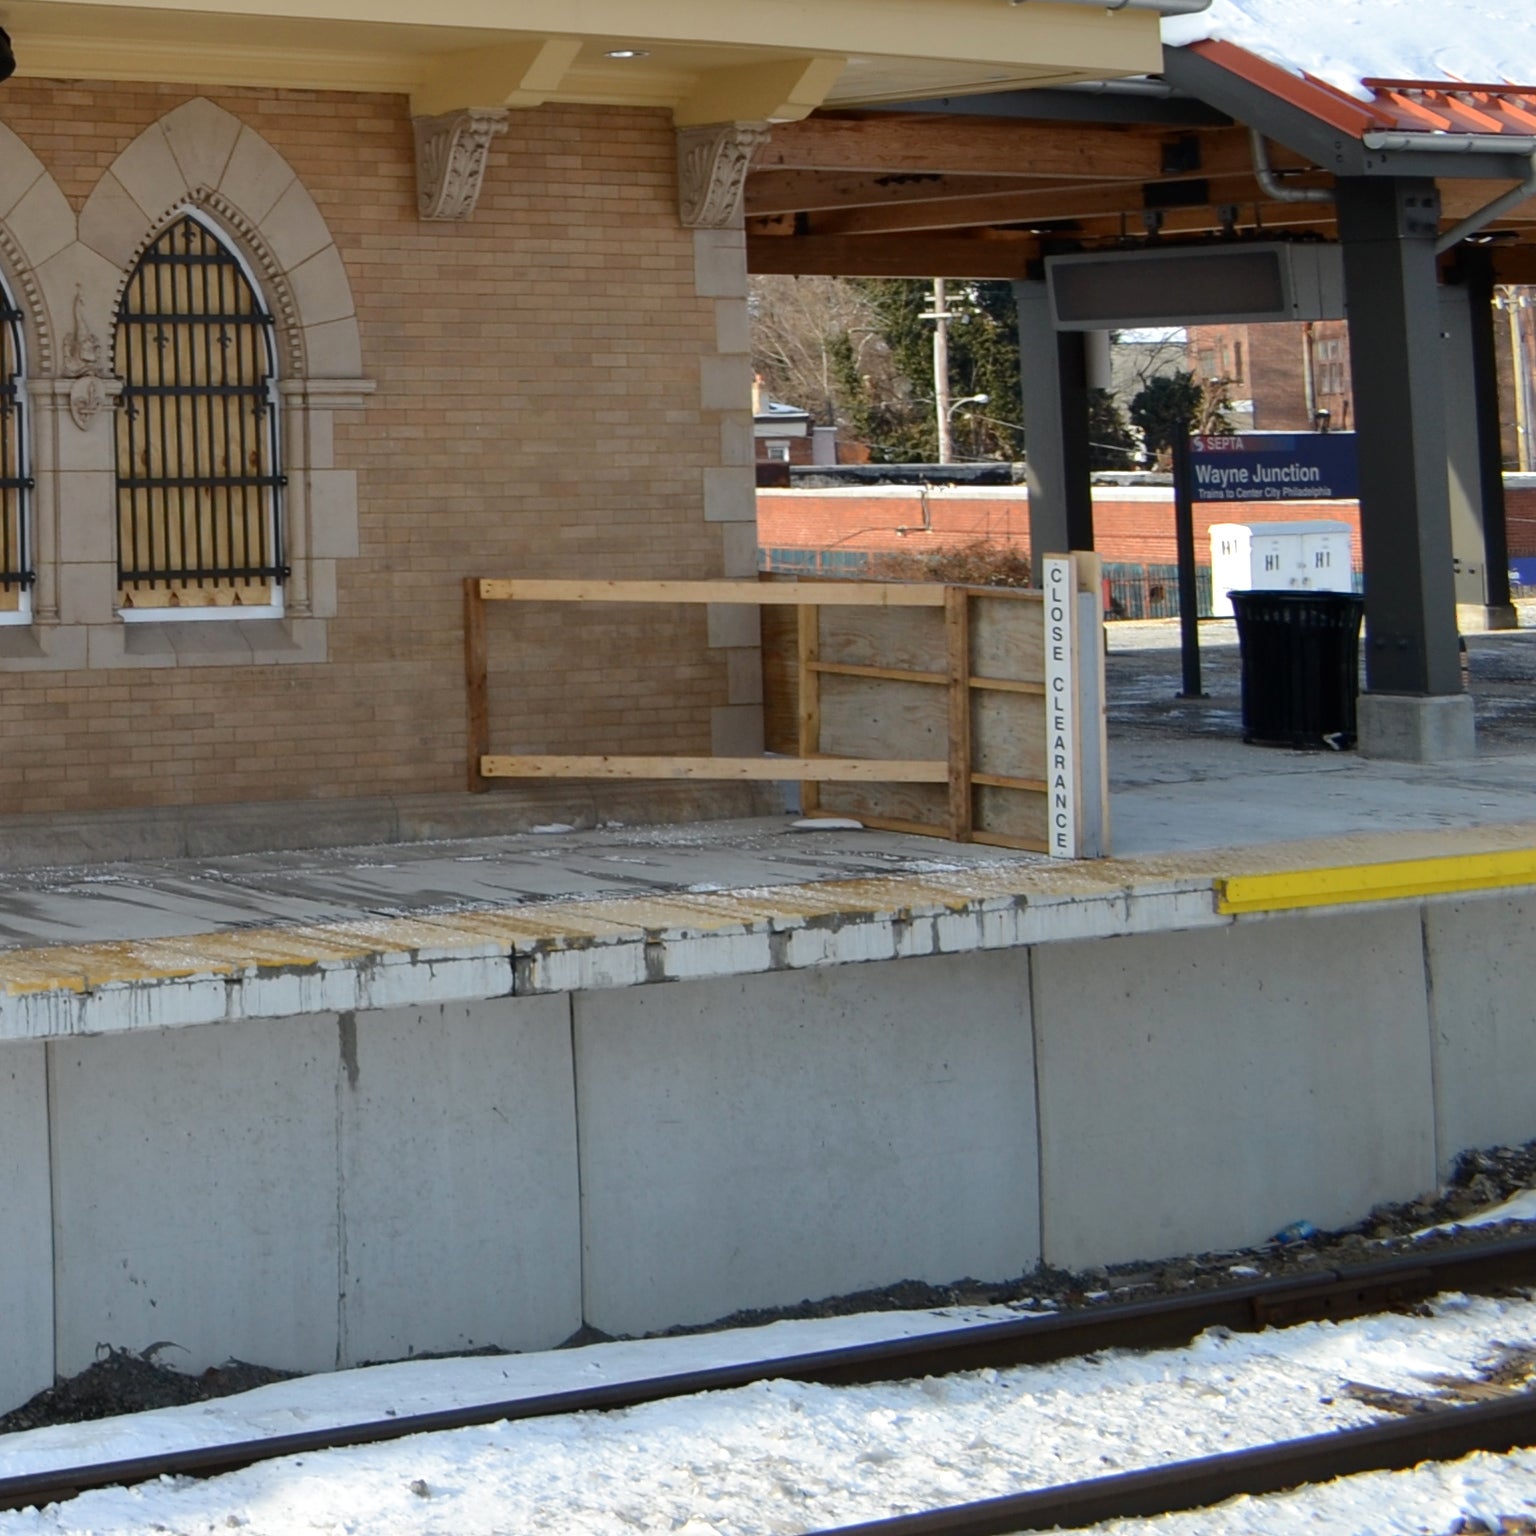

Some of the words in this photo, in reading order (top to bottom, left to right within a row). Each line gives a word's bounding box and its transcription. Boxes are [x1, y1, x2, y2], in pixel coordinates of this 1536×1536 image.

[1207, 437, 1245, 451] SEPTA
[1195, 465, 1249, 489] Wayne
[1252, 463, 1320, 483] Junction
[1198, 488, 1225, 499] Trains
[1225, 488, 1235, 498] to
[1236, 487, 1263, 498] Center
[1264, 486, 1281, 500] City
[1282, 485, 1332, 498] Philadelphia
[1050, 568, 1064, 661] CLOSE
[1052, 677, 1068, 849] CLEARANCE
